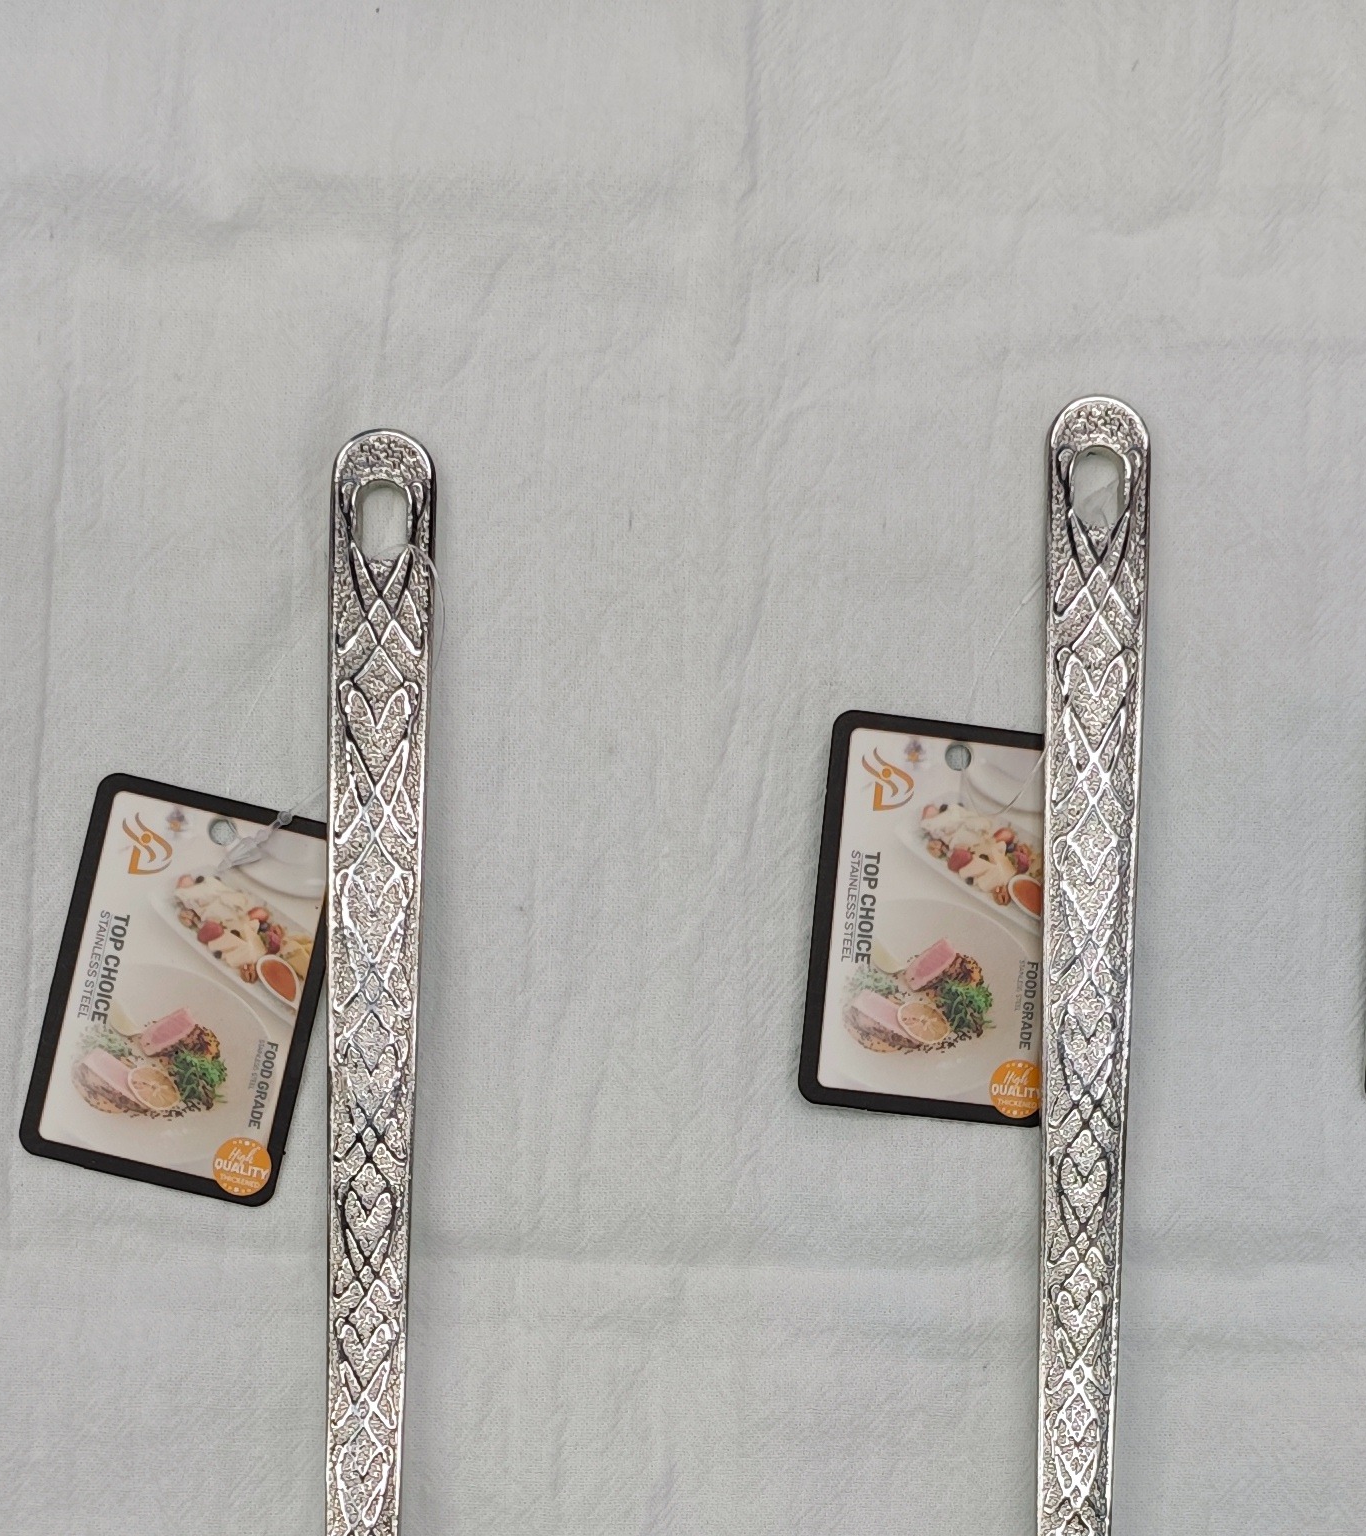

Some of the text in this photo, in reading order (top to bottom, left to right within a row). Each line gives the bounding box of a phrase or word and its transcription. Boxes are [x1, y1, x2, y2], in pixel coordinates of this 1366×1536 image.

[840, 849, 861, 962] STAINLESS STEEL
[854, 851, 881, 964] TOP CHOICE
[76, 909, 110, 1018] STAINLESS STEEL
[90, 914, 131, 1024] TOP CHOICE
[1018, 961, 1039, 1050] FOOD GRADE
[247, 1041, 279, 1129] FOOD GRADE
[1002, 1066, 1034, 1086] High
[214, 1157, 269, 1179] QUALITY
[227, 1145, 261, 1164] High
